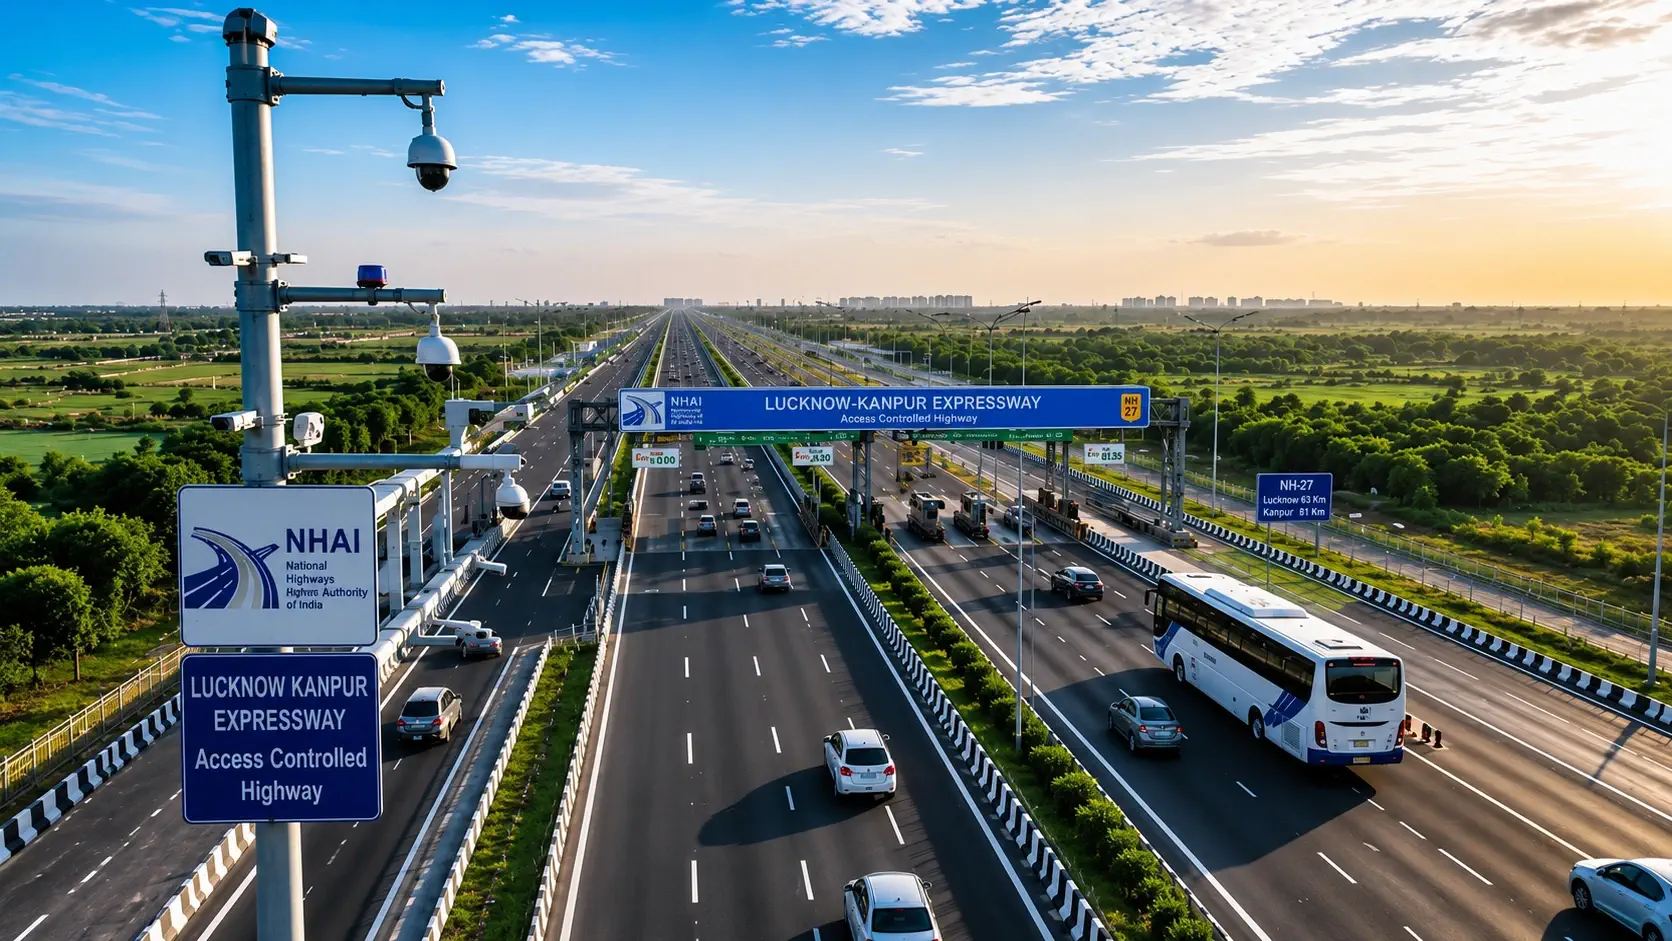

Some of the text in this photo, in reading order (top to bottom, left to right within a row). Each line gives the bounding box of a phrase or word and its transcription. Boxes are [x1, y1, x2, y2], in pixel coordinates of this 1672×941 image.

[671, 396, 702, 407] NHAI
[765, 396, 1042, 411] LUCKNOW-KANPUR EXPRESSWAY
[1124, 397, 1138, 405] NH
[1124, 406, 1138, 417] 27
[840, 413, 978, 425] Access Controlled Highway
[1279, 479, 1314, 491] NH-27
[1263, 495, 1327, 505] Lucknow 63 Km
[1263, 507, 1294, 519] Kanpur
[1311, 507, 1326, 517] Km
[286, 528, 360, 554] NHAI
[286, 560, 328, 571] National
[286, 574, 335, 587] Highways
[322, 587, 369, 599] Authority
[286, 600, 323, 610] of India
[191, 675, 369, 698] LUCKNOW KANPUR
[214, 709, 346, 731] EXPRESSWAY
[194, 746, 367, 770] Access Controlled
[241, 780, 323, 806] Highway
